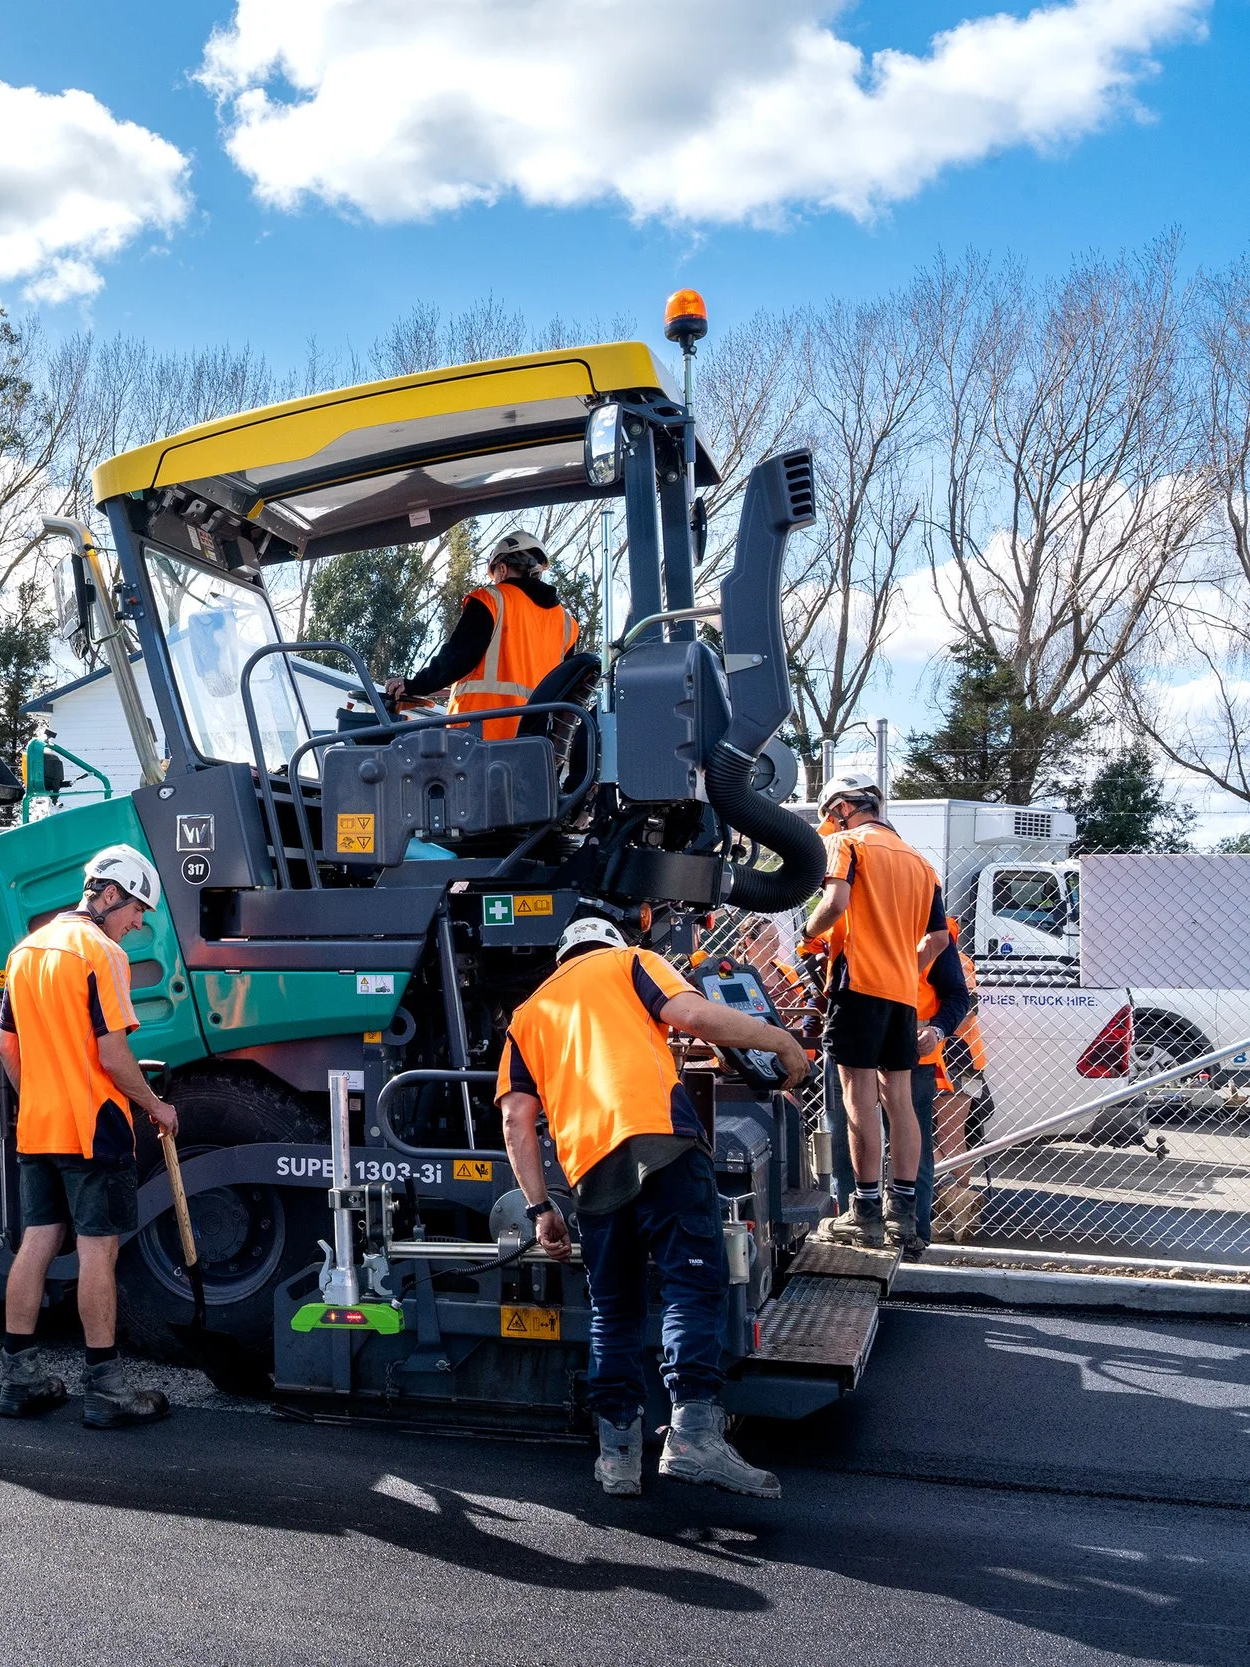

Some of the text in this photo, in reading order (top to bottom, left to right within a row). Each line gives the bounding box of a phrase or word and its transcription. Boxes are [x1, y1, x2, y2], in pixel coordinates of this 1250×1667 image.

[182, 823, 209, 844] W
[187, 863, 205, 876] 317
[1022, 995, 1064, 1006] TRUCK
[1066, 996, 1098, 1007] HIRE.
[276, 1156, 443, 1184] SUPE 1303-3i
